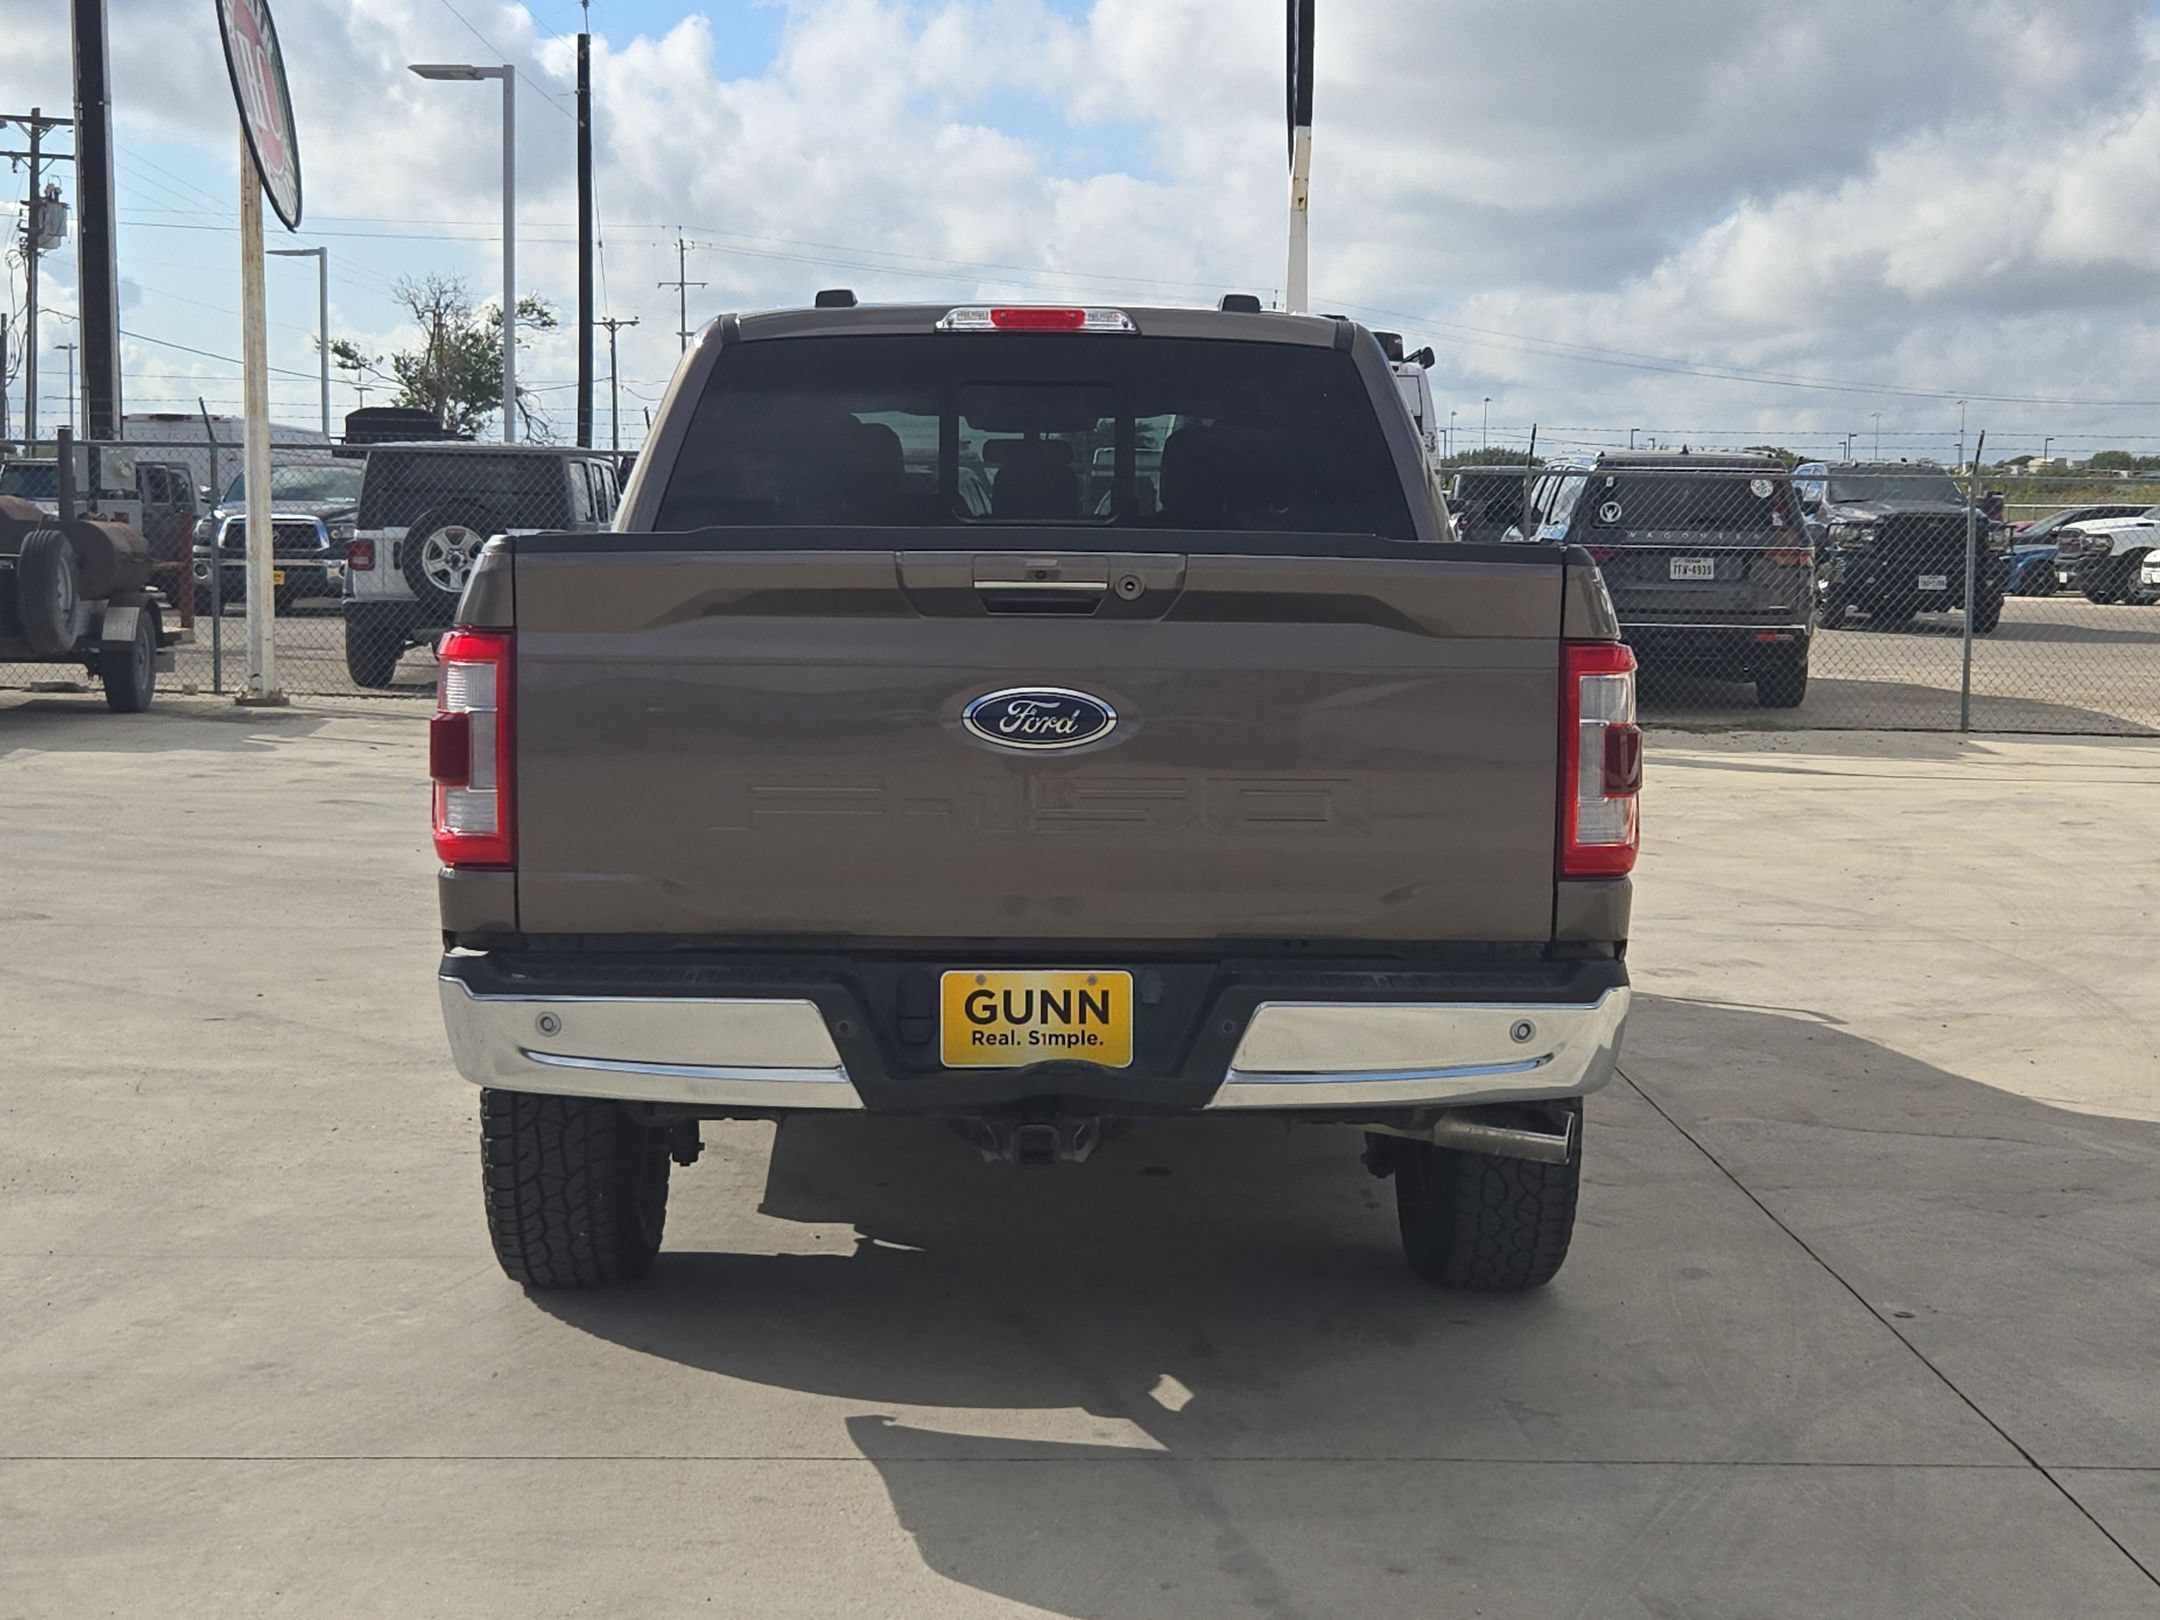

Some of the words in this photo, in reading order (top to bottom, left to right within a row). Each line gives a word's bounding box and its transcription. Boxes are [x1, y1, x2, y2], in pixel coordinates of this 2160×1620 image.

[999, 699, 1081, 734] Ford
[964, 989, 1110, 1025] GUNN
[971, 1030, 1021, 1046] Real.
